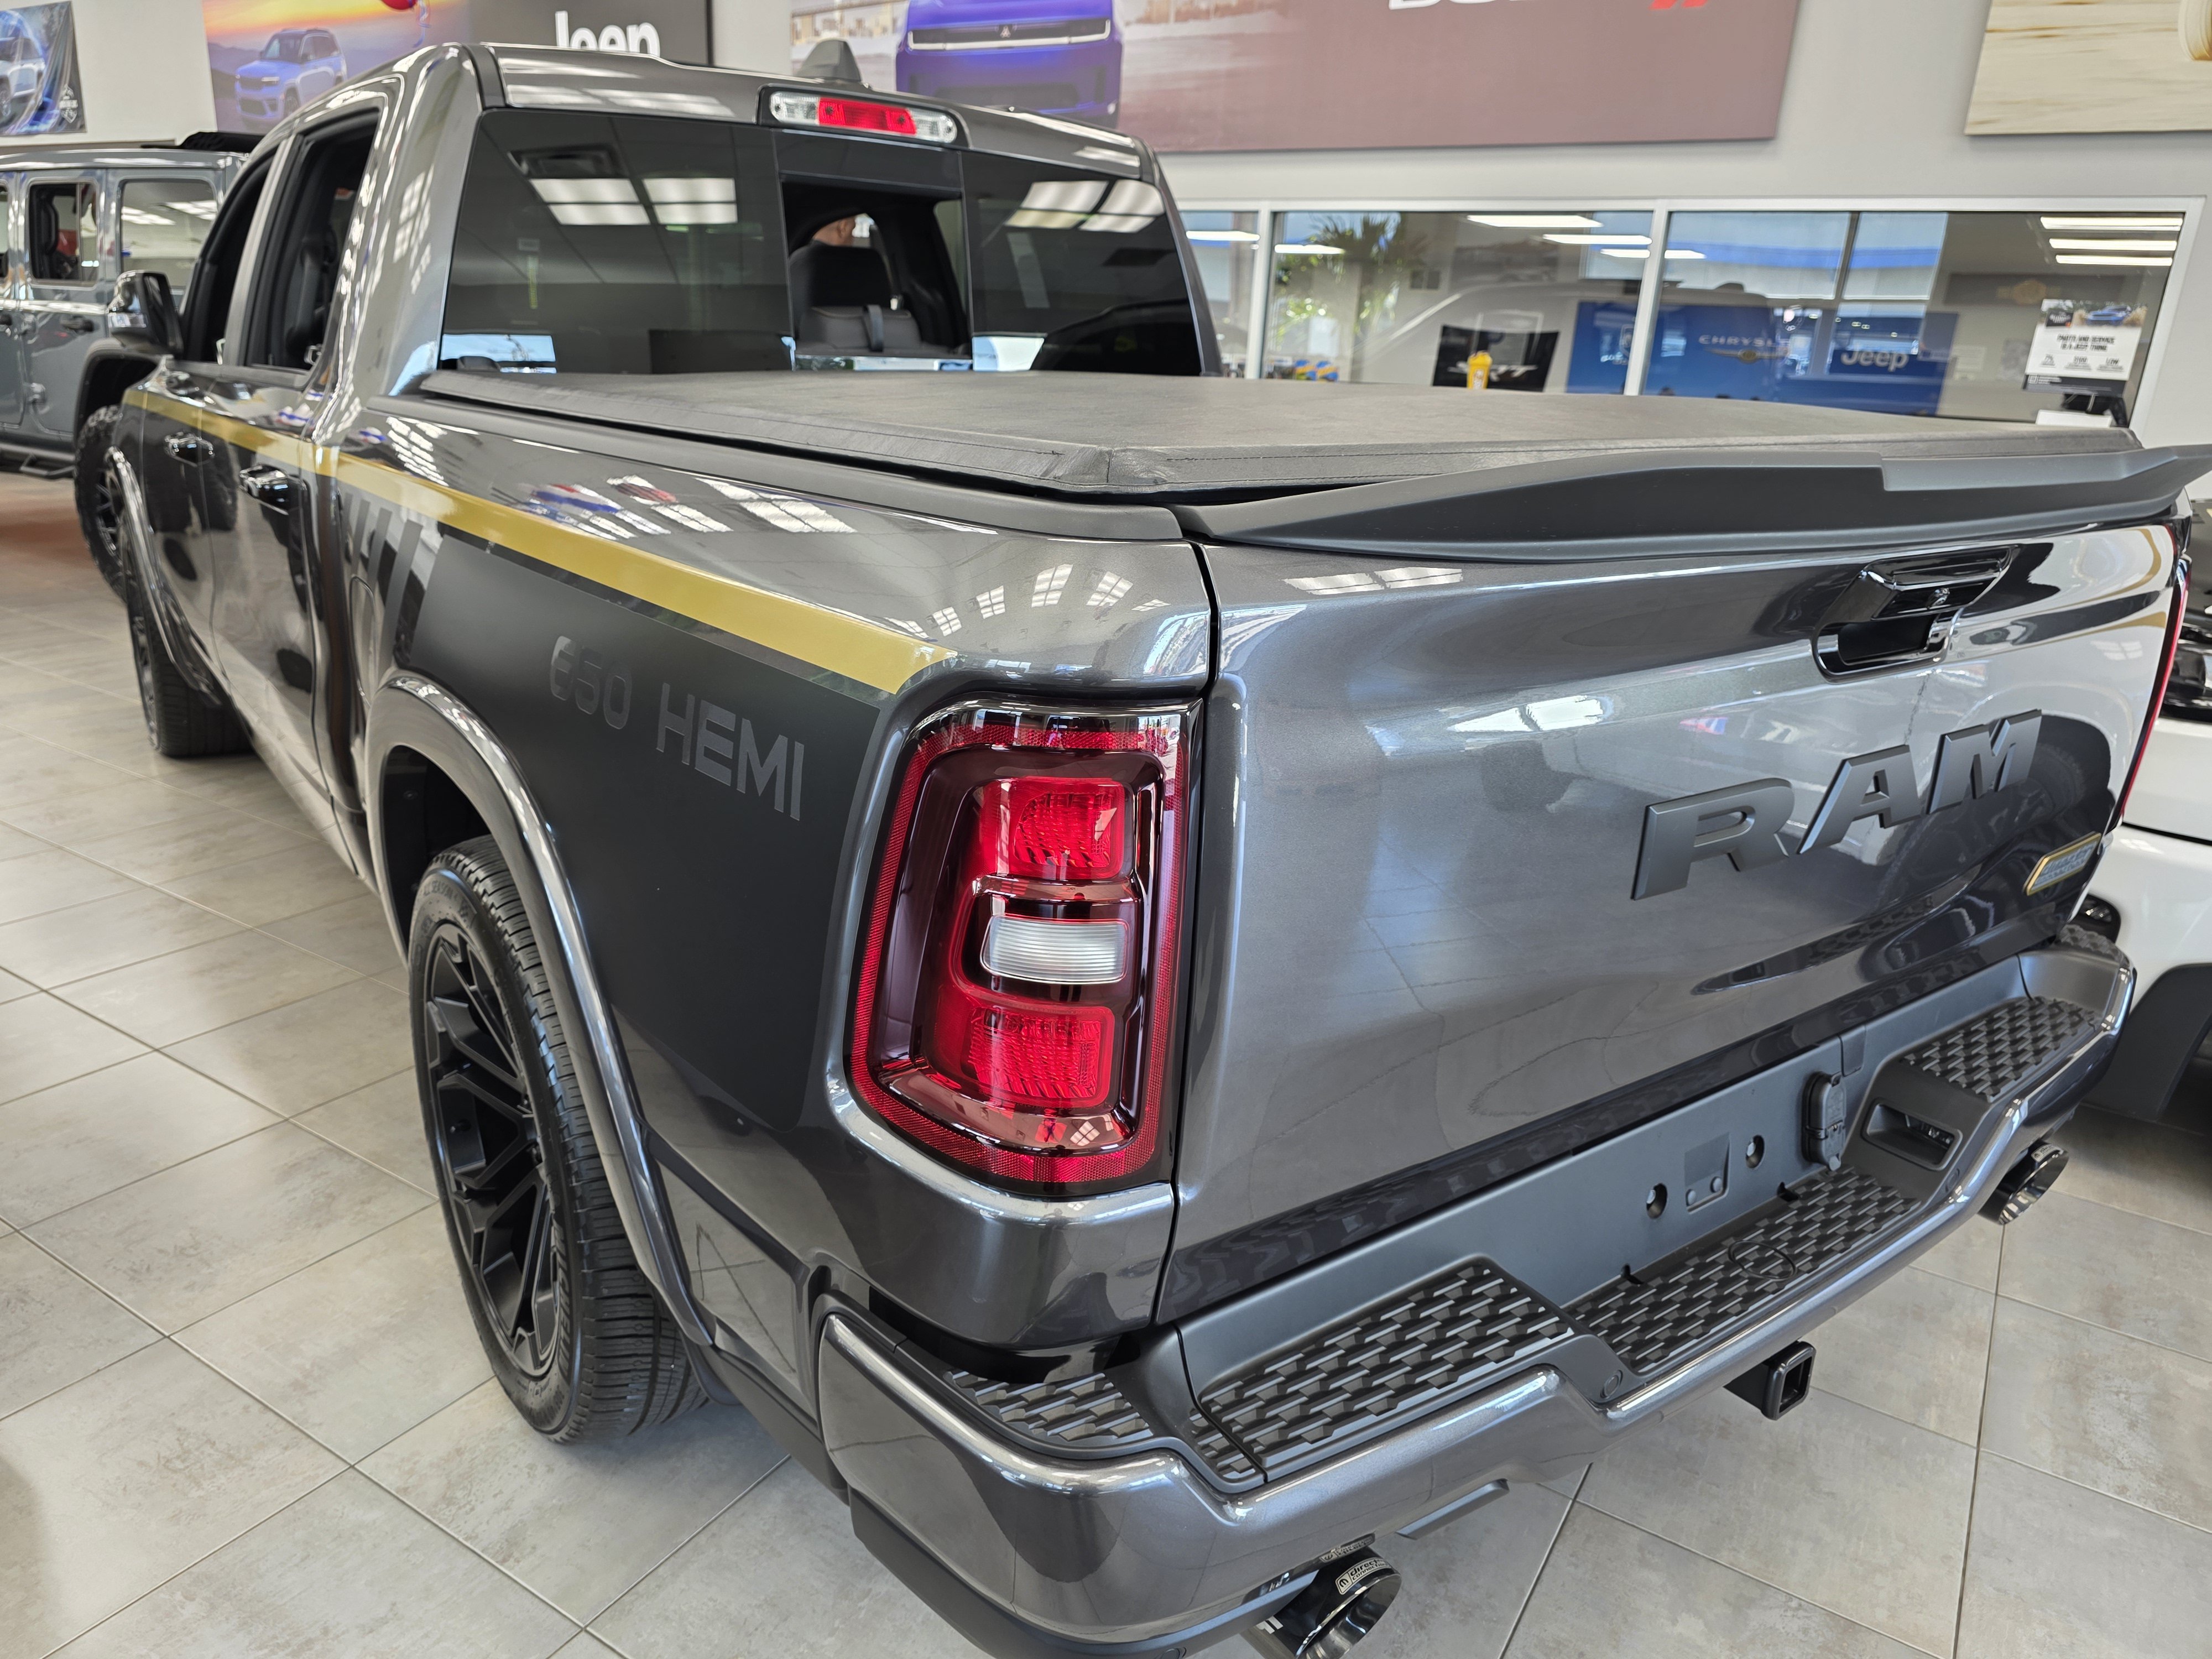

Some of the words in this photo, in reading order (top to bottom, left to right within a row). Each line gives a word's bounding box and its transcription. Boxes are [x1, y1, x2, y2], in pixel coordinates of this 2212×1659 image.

[1840, 343, 1909, 372] Jeep
[655, 682, 805, 821] HEMI
[1630, 708, 2043, 901] RAM
[552, 1218, 571, 1378] MICHELIN
[1350, 1559, 1378, 1577] direct
